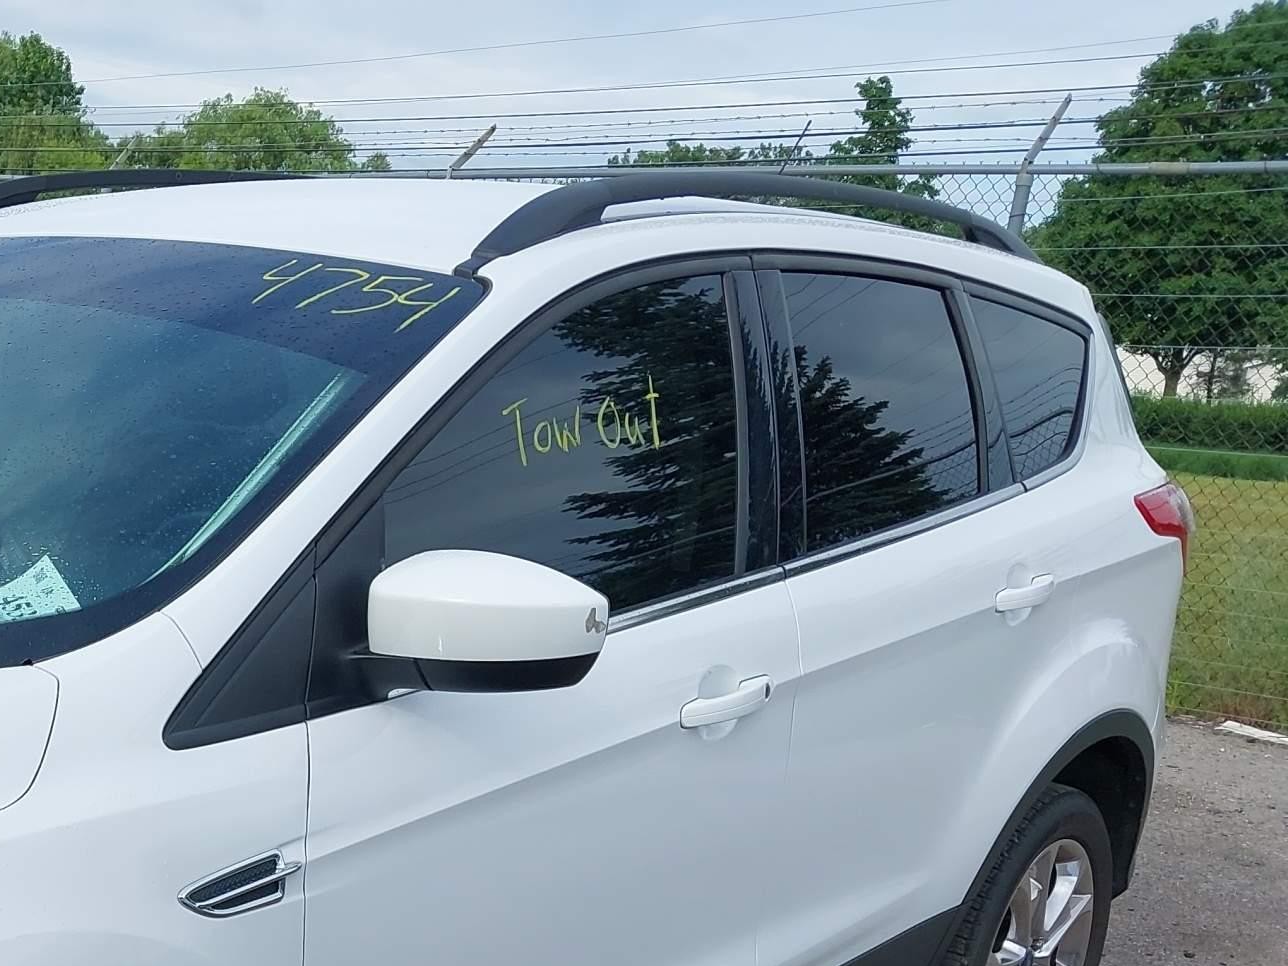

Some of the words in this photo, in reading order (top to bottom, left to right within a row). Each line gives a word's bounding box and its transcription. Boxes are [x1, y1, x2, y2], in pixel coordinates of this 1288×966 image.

[251, 258, 461, 334] 4754
[501, 398, 582, 467] Tow
[597, 371, 660, 450] Out
